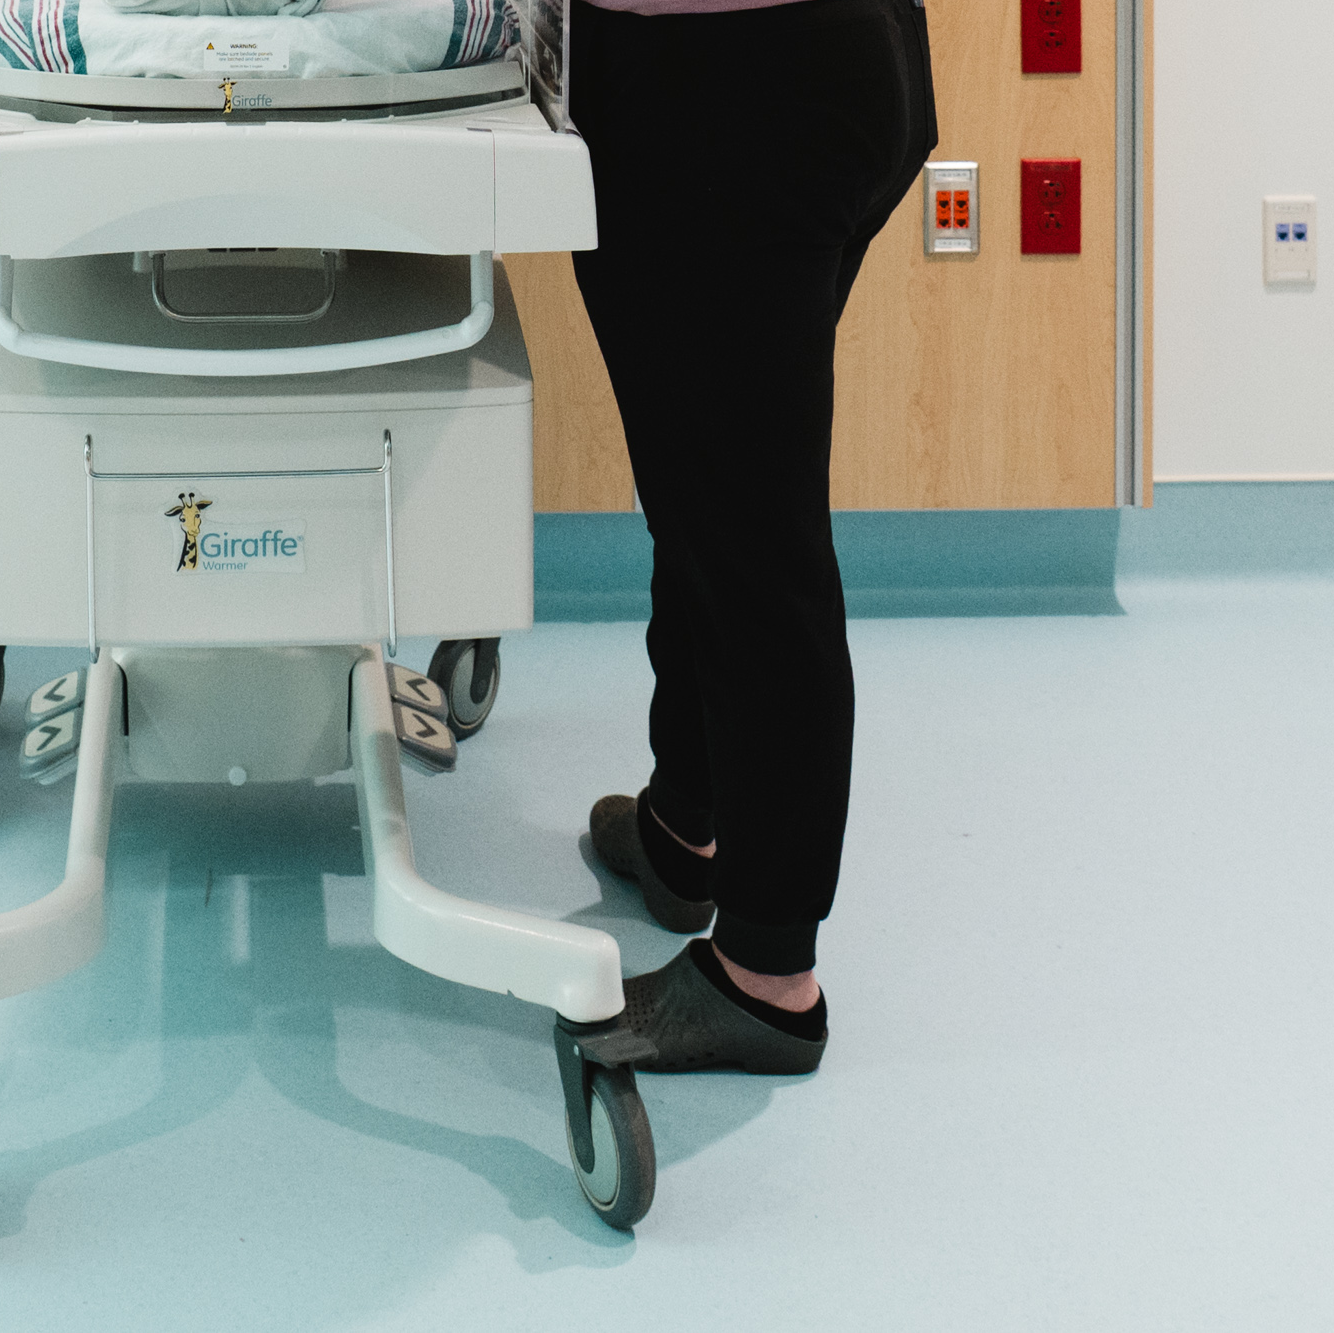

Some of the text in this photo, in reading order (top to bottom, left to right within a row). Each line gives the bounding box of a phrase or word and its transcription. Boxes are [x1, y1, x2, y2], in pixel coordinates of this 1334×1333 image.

[232, 94, 272, 107] Giraffe
[200, 530, 298, 558] Giraffe
[202, 561, 248, 570] Warmer
